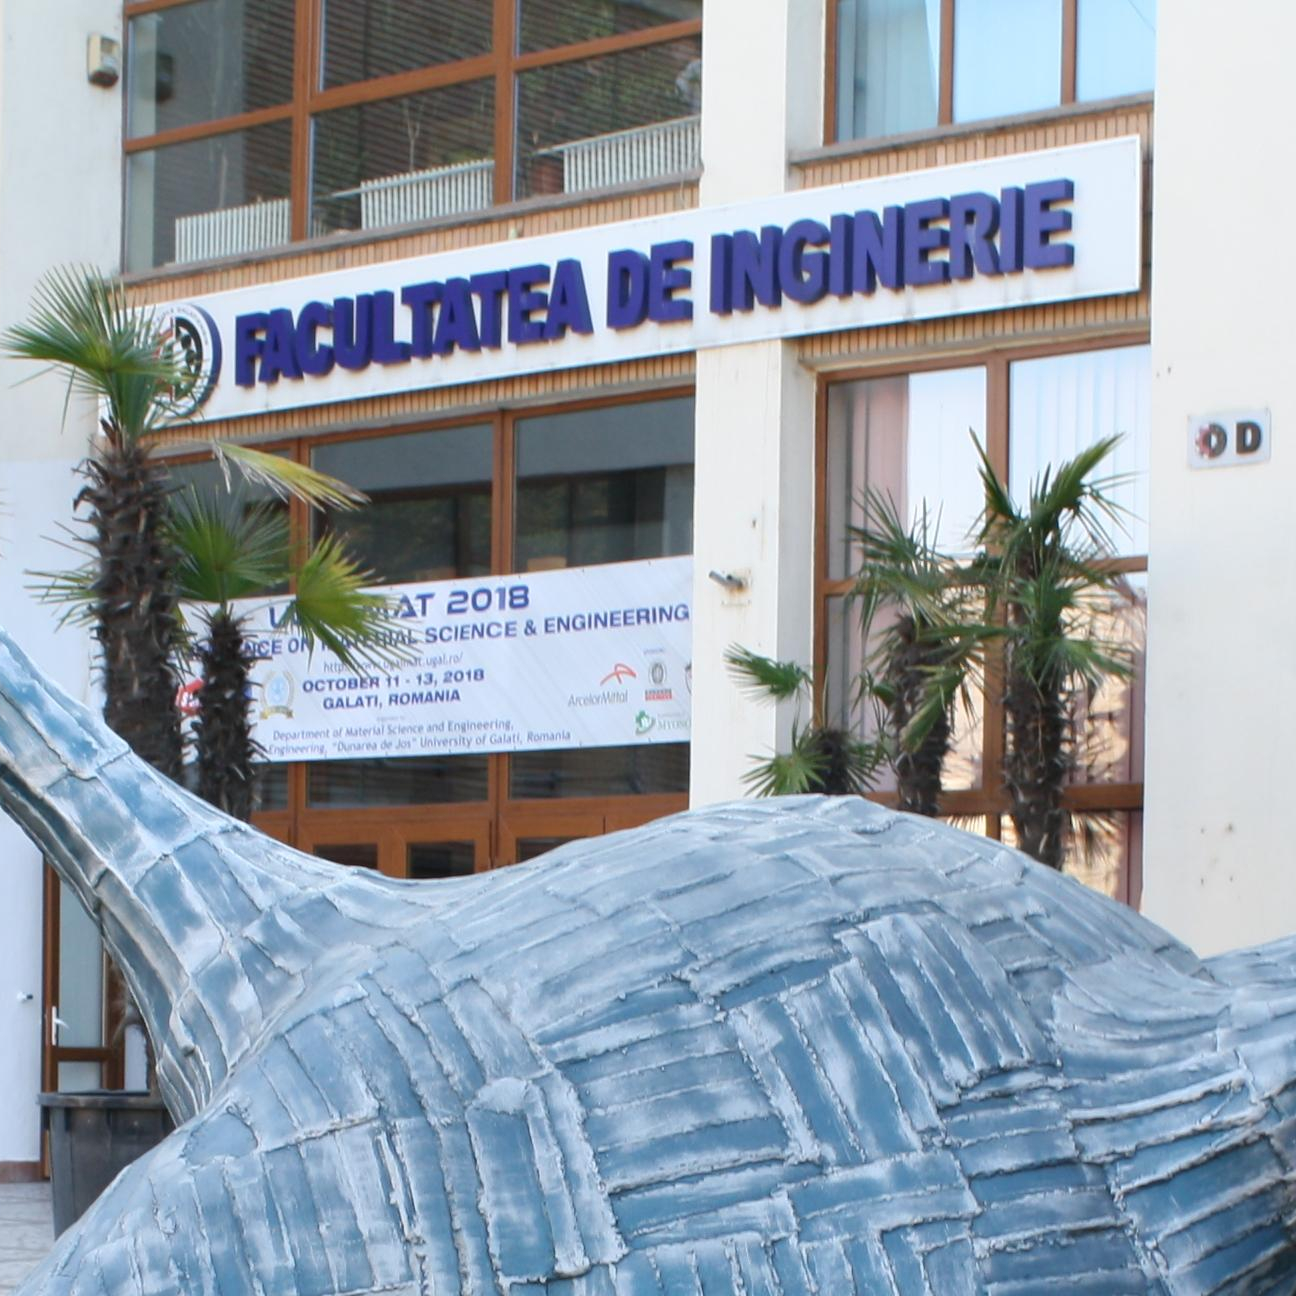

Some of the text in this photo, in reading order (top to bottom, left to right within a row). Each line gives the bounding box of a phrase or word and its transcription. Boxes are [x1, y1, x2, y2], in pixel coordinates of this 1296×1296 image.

[235, 178, 1074, 387] FACULTATEA DE INGINERIE
[447, 585, 530, 615] 2018
[425, 619, 517, 644] SCIENCE
[524, 619, 537, 637] &
[544, 603, 690, 633] ENGINEERING
[302, 676, 380, 692] OCTOBER
[386, 676, 400, 688] 11
[416, 673, 437, 687] 13,
[443, 668, 485, 684] 2018
[388, 689, 461, 706] ROMANIA
[568, 689, 628, 707] ArcelorMittal
[273, 719, 513, 742] Department of Material Science and Engineering,
[381, 739, 392, 750] de
[420, 735, 473, 749] University
[476, 733, 486, 745] of
[527, 729, 571, 743] Romania
